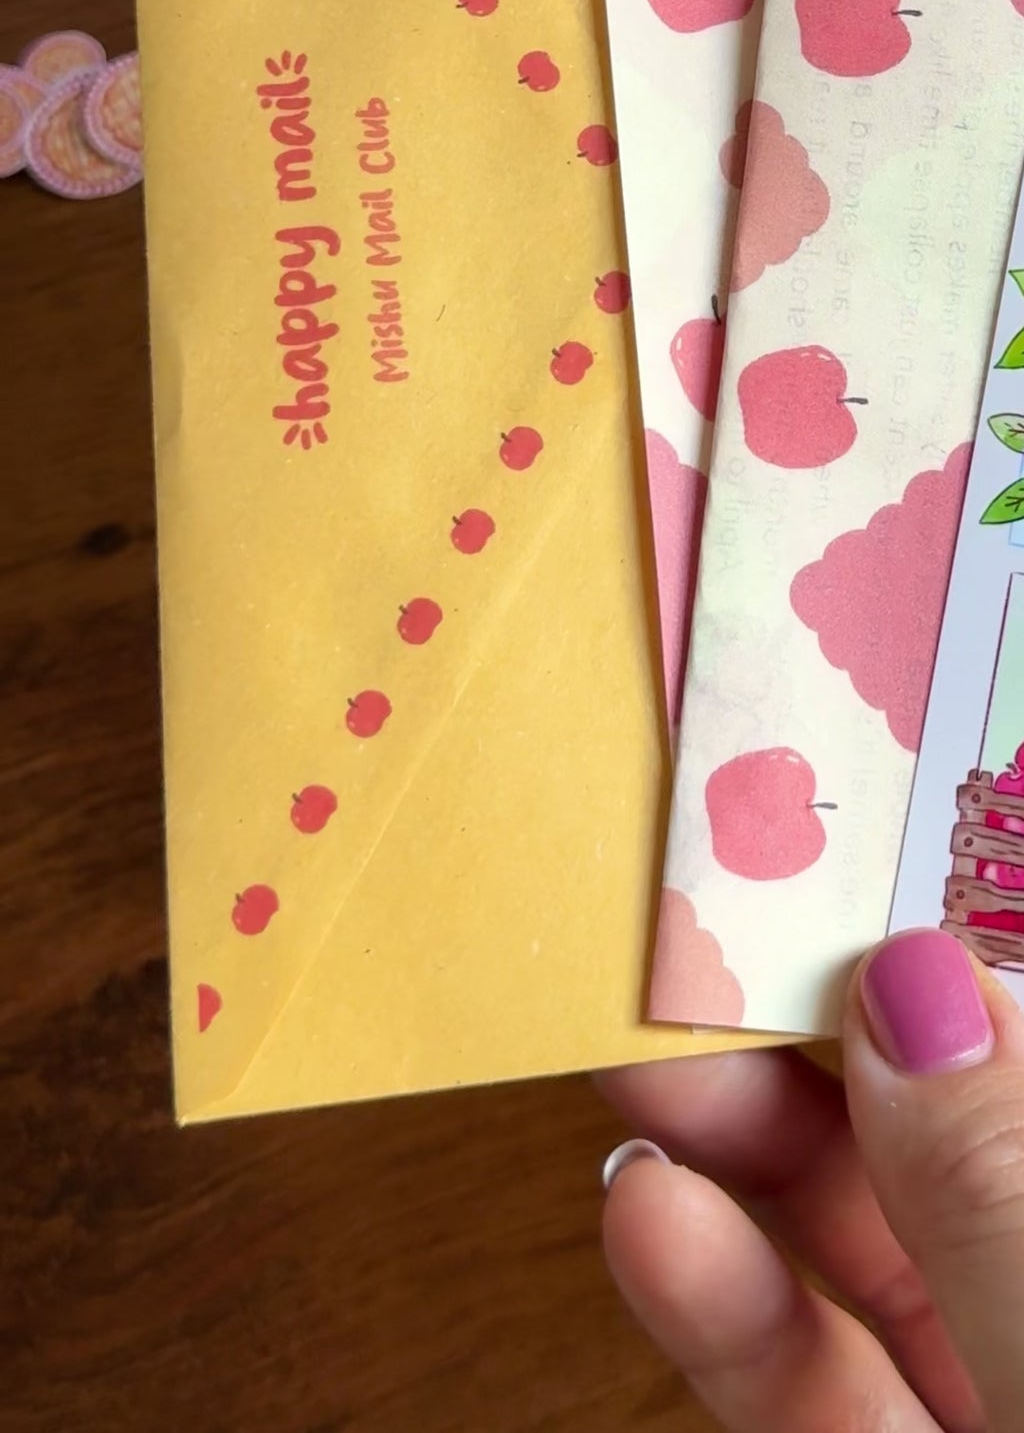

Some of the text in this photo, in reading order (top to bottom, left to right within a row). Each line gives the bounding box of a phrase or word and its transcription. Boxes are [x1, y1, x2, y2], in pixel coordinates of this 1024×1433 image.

[255, 75, 341, 421] happy mail
[354, 96, 410, 383] Mishu Mail Club
